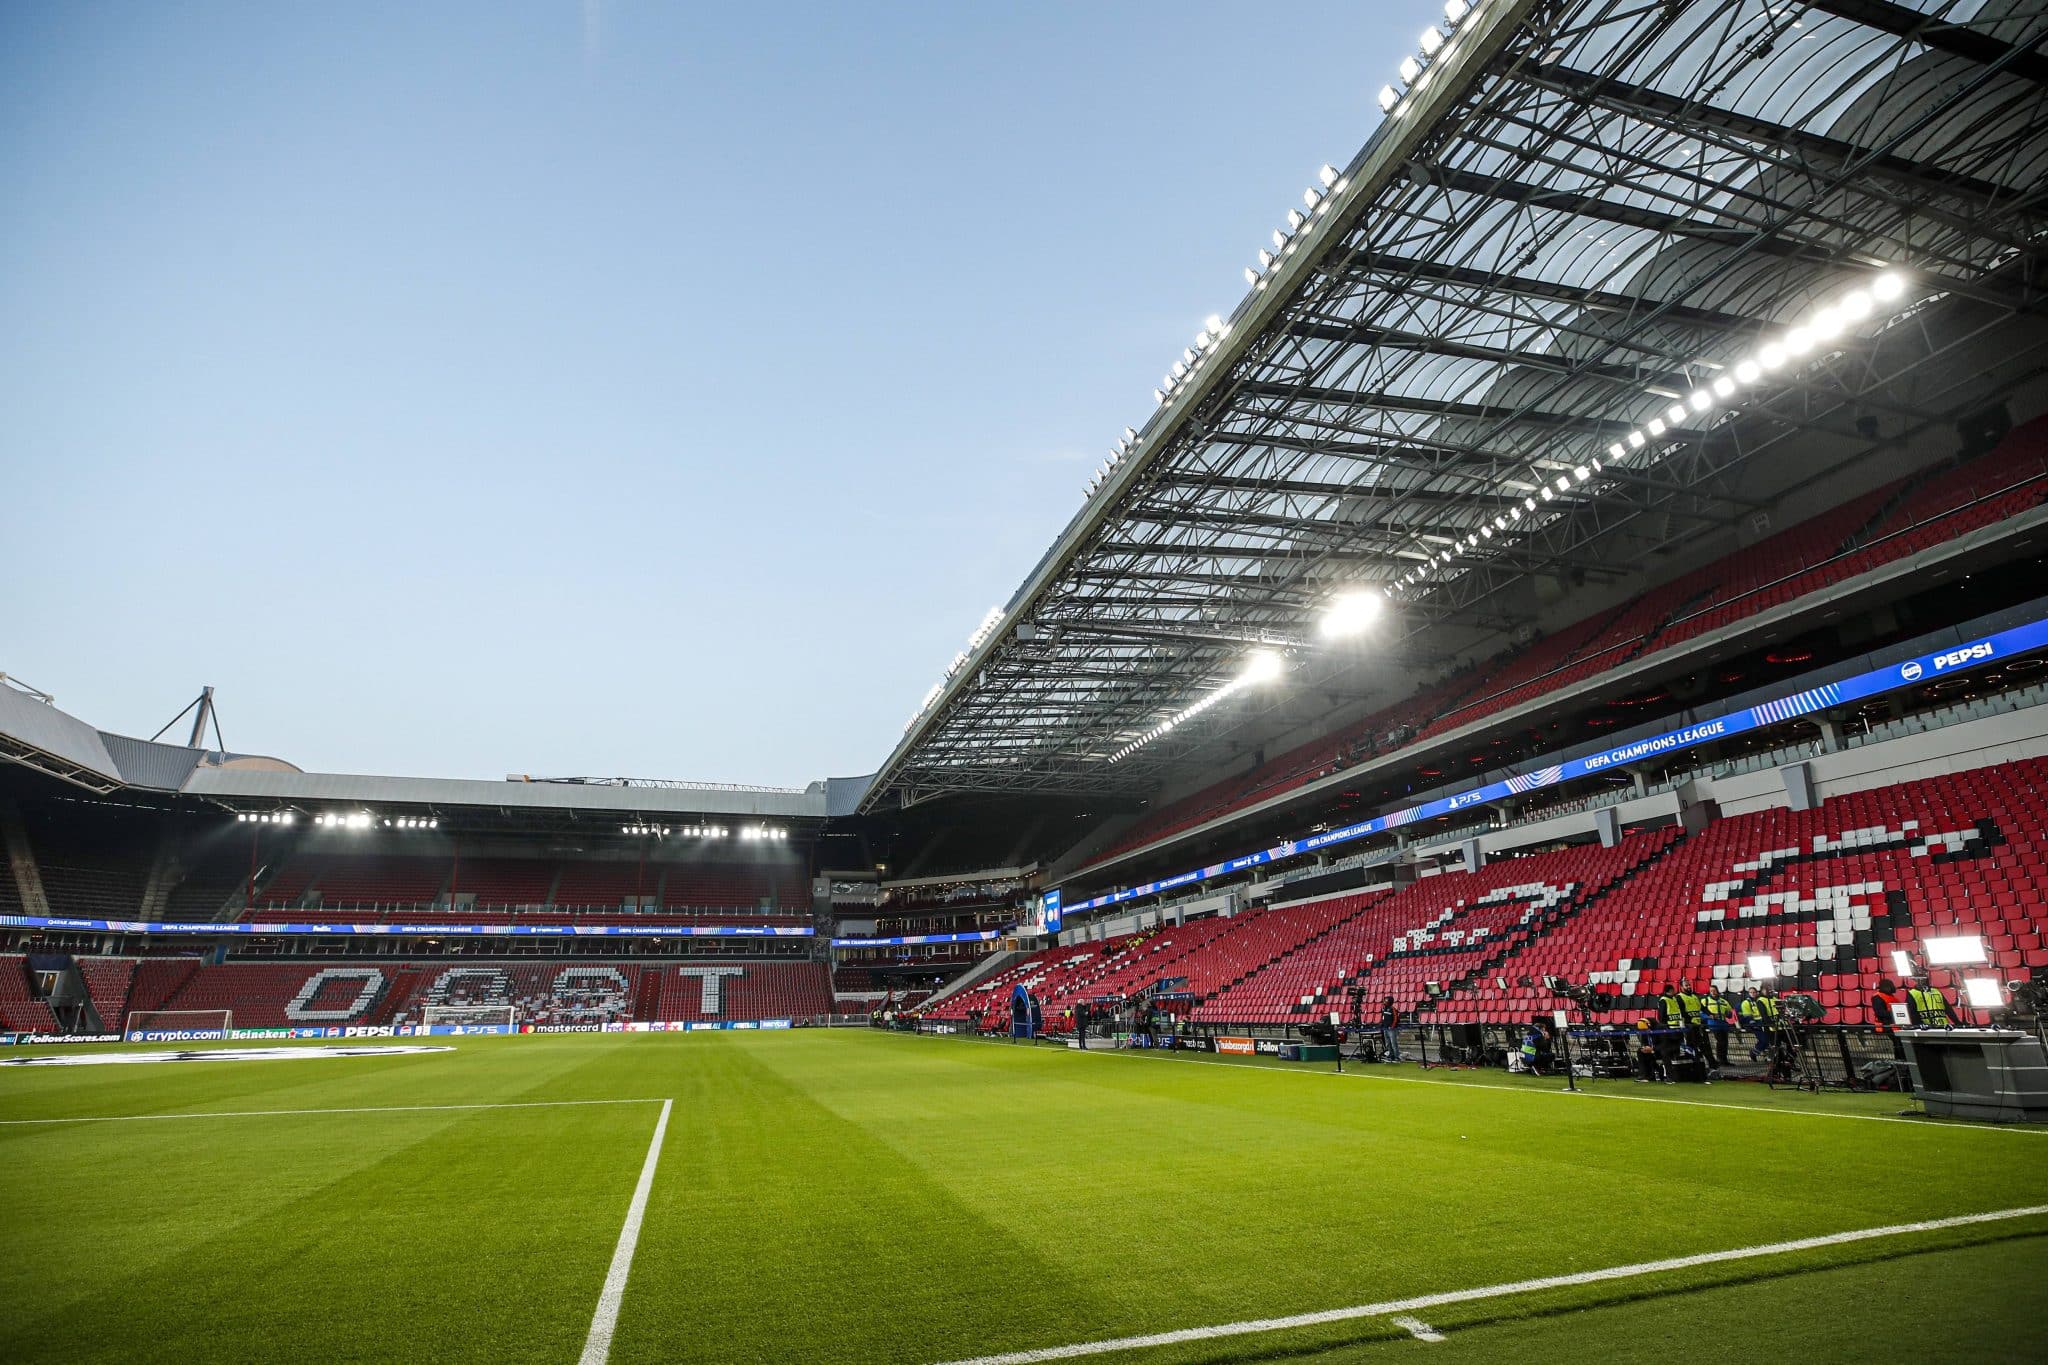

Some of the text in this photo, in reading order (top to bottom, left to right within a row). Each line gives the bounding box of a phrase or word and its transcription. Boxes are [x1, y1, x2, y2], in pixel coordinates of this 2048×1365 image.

[1932, 642, 1994, 670] PEPSI
[1584, 722, 1725, 770] UEFA CHAMPIONS LEAGUE
[1458, 792, 1482, 806] PS5
[1307, 823, 1373, 849] UEFA CHAMPIONS LEAGUE
[345, 1026, 394, 1038] PEPSI
[466, 1026, 498, 1035] PS5
[537, 1024, 599, 1033] mastercard
[607, 1021, 638, 1032] FedEx
[649, 1021, 680, 1031] FedEx
[146, 1030, 222, 1043] crypto.com
[231, 1029, 287, 1040] Heineken
